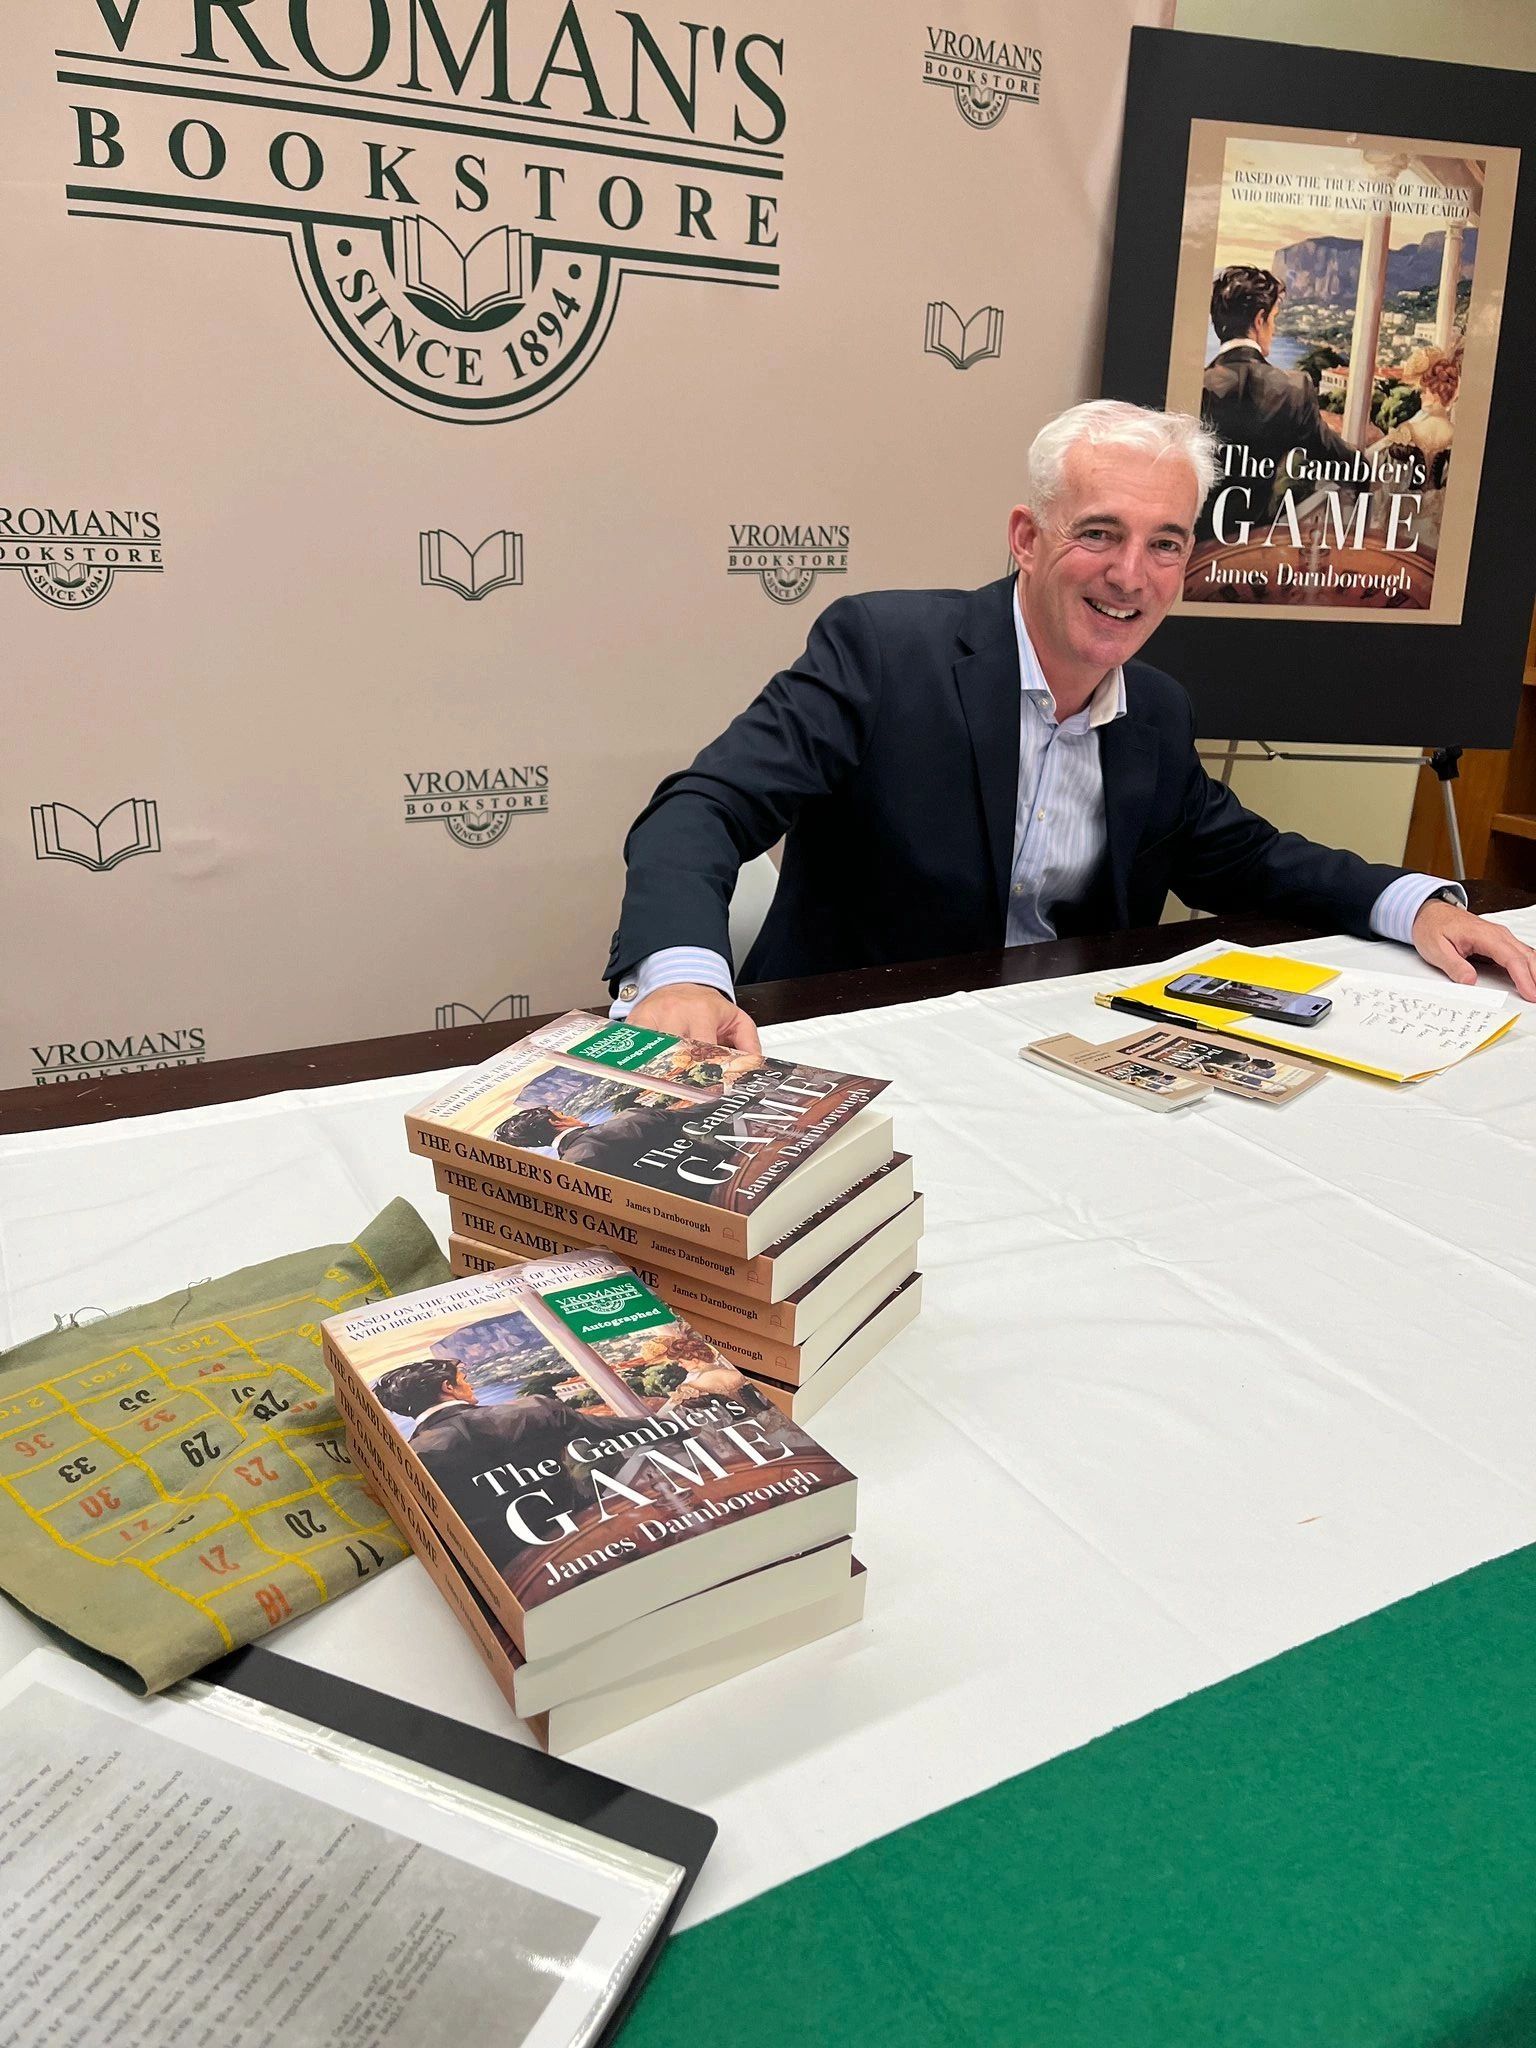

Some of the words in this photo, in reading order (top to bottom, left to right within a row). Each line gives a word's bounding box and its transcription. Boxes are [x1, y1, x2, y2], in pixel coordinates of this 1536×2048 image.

[926, 26, 1042, 73] VROMAN'S
[925, 61, 1040, 95] BOOKSTORE
[962, 94, 983, 121] SINCE
[69, 106, 780, 248] BOOKSTORE
[1235, 170, 1273, 185] BASED
[1275, 174, 1293, 186] ON
[1296, 175, 1321, 190] THE
[1323, 178, 1355, 192] TRUE
[1358, 180, 1395, 194] STORY
[1398, 183, 1414, 196] OF
[1417, 184, 1441, 198] THE
[1443, 186, 1471, 201] MAN
[1231, 188, 1262, 201] WHO
[1265, 190, 1303, 204] BROKE
[1307, 193, 1331, 208] THE
[1335, 196, 1367, 211] BANK
[1369, 199, 1384, 211] AT
[1388, 201, 1429, 216] MONTE
[1431, 203, 1471, 219] CARLO
[337, 266, 482, 386] SINCE
[501, 288, 580, 379] 1894
[1219, 443, 1275, 479] The
[1285, 447, 1426, 485] Gambler's
[0, 507, 161, 538] ROMAN'S
[728, 524, 850, 547] VROMAN'S
[1212, 485, 1422, 553] GAME
[0, 546, 162, 562] OKSTORE
[729, 554, 848, 567] BOOKSTORE
[34, 574, 77, 601] SINCE
[81, 576, 103, 599] 1894
[1205, 560, 1269, 585] James
[1277, 562, 1411, 597] Darnborough
[403, 765, 549, 794] VROMAN'S
[407, 795, 548, 815] BOOKSTORE
[454, 823, 483, 841] SINCE
[29, 1027, 206, 1067] VROMAN'S
[578, 1026, 636, 1056] VROMAN'S
[616, 1037, 666, 1066] Autographed
[633, 1137, 693, 1170] The
[682, 1069, 783, 1136] Gambler's
[676, 1074, 839, 1186] GAME
[735, 1158, 790, 1201] James
[786, 1087, 871, 1157] Darnborough
[417, 1130, 451, 1153] THE
[454, 1142, 552, 1185] GAMBLER'S
[556, 1174, 613, 1204] GAME
[625, 1199, 651, 1214] James
[653, 1207, 711, 1234] Darnborough
[444, 1169, 478, 1193] THE
[481, 1182, 579, 1226] GAMBLER'S
[582, 1214, 639, 1245] GAME
[650, 1240, 676, 1257] James
[678, 1249, 736, 1277] Darnborough
[461, 1212, 496, 1235] THE
[672, 1284, 699, 1301] James
[700, 1293, 759, 1320] Darnborough
[345, 1312, 391, 1333] BASED
[393, 1306, 414, 1318] ON
[418, 1298, 446, 1310] THE
[449, 1287, 484, 1302] TRUE
[485, 1277, 527, 1291] STORY
[529, 1270, 546, 1280] OF
[549, 1264, 574, 1275] THE
[577, 1257, 605, 1269] MAN
[349, 1326, 387, 1342] WHO
[389, 1311, 437, 1330] BROKE
[439, 1302, 468, 1315] THE
[469, 1290, 507, 1308] BANK
[509, 1285, 525, 1296] AT
[527, 1275, 572, 1292] MONTE
[574, 1264, 614, 1281] CARLO
[461, 1252, 496, 1272] THE
[704, 1334, 764, 1361] Darnborough
[555, 1282, 635, 1306] VROMAN'S
[581, 1308, 662, 1333] Autographed
[118, 1389, 157, 1413] 35
[253, 1389, 290, 1422] 28
[138, 1409, 177, 1433] 32
[327, 1345, 348, 1384] THE
[347, 1375, 404, 1466] GAMBLER'S
[404, 1459, 440, 1519] GAME
[14, 1433, 55, 1458] 36
[180, 1429, 222, 1468] 29
[472, 1456, 562, 1498] The
[566, 1399, 747, 1464] Gambler's
[58, 1456, 97, 1484] 33
[233, 1456, 280, 1487] 23
[338, 1388, 358, 1427] THE
[356, 1416, 407, 1514] GAMBLER'S
[407, 1507, 440, 1569] GAME
[505, 1418, 795, 1547] GAME
[78, 1486, 121, 1518] 30
[284, 1509, 328, 1539] 20
[544, 1534, 638, 1586] James
[637, 1468, 822, 1542] Darnborough
[345, 1539, 386, 1579] 17
[254, 1583, 294, 1628] 18
